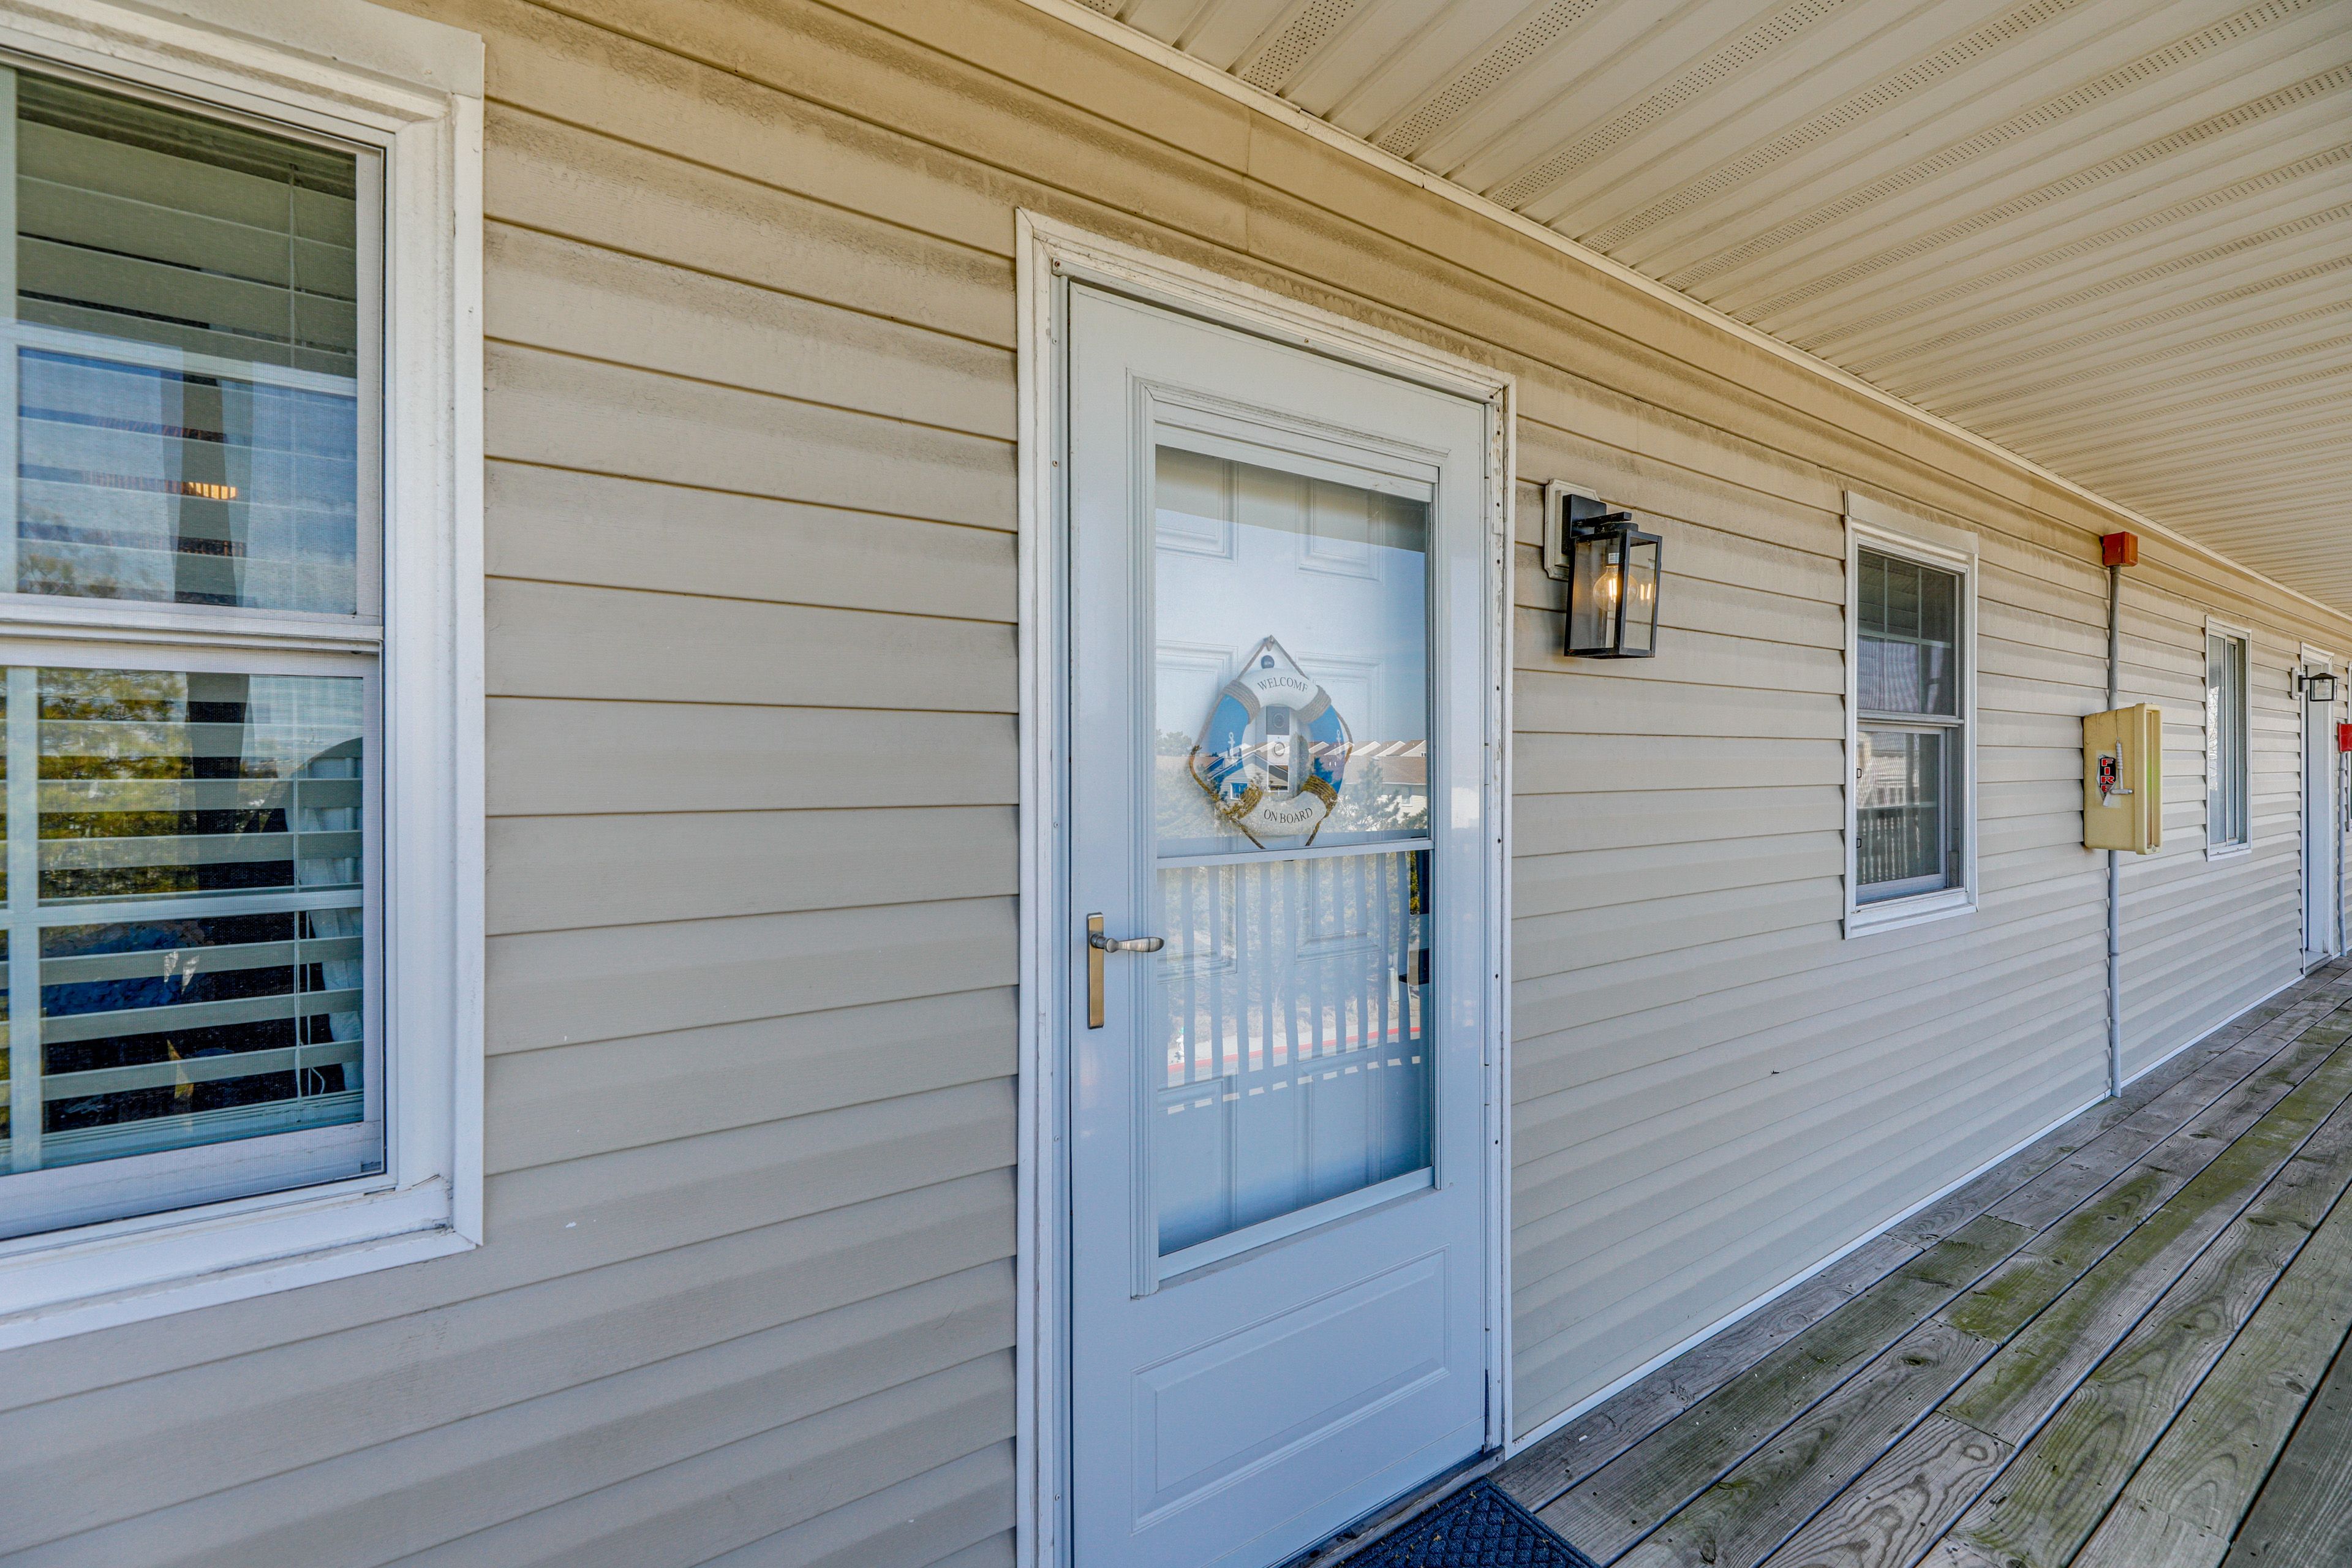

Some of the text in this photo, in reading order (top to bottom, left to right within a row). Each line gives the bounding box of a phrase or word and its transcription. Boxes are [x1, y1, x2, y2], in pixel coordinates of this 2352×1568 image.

[1257, 677, 1308, 692] WELCOME
[1264, 808, 1313, 824] ON BOARD
